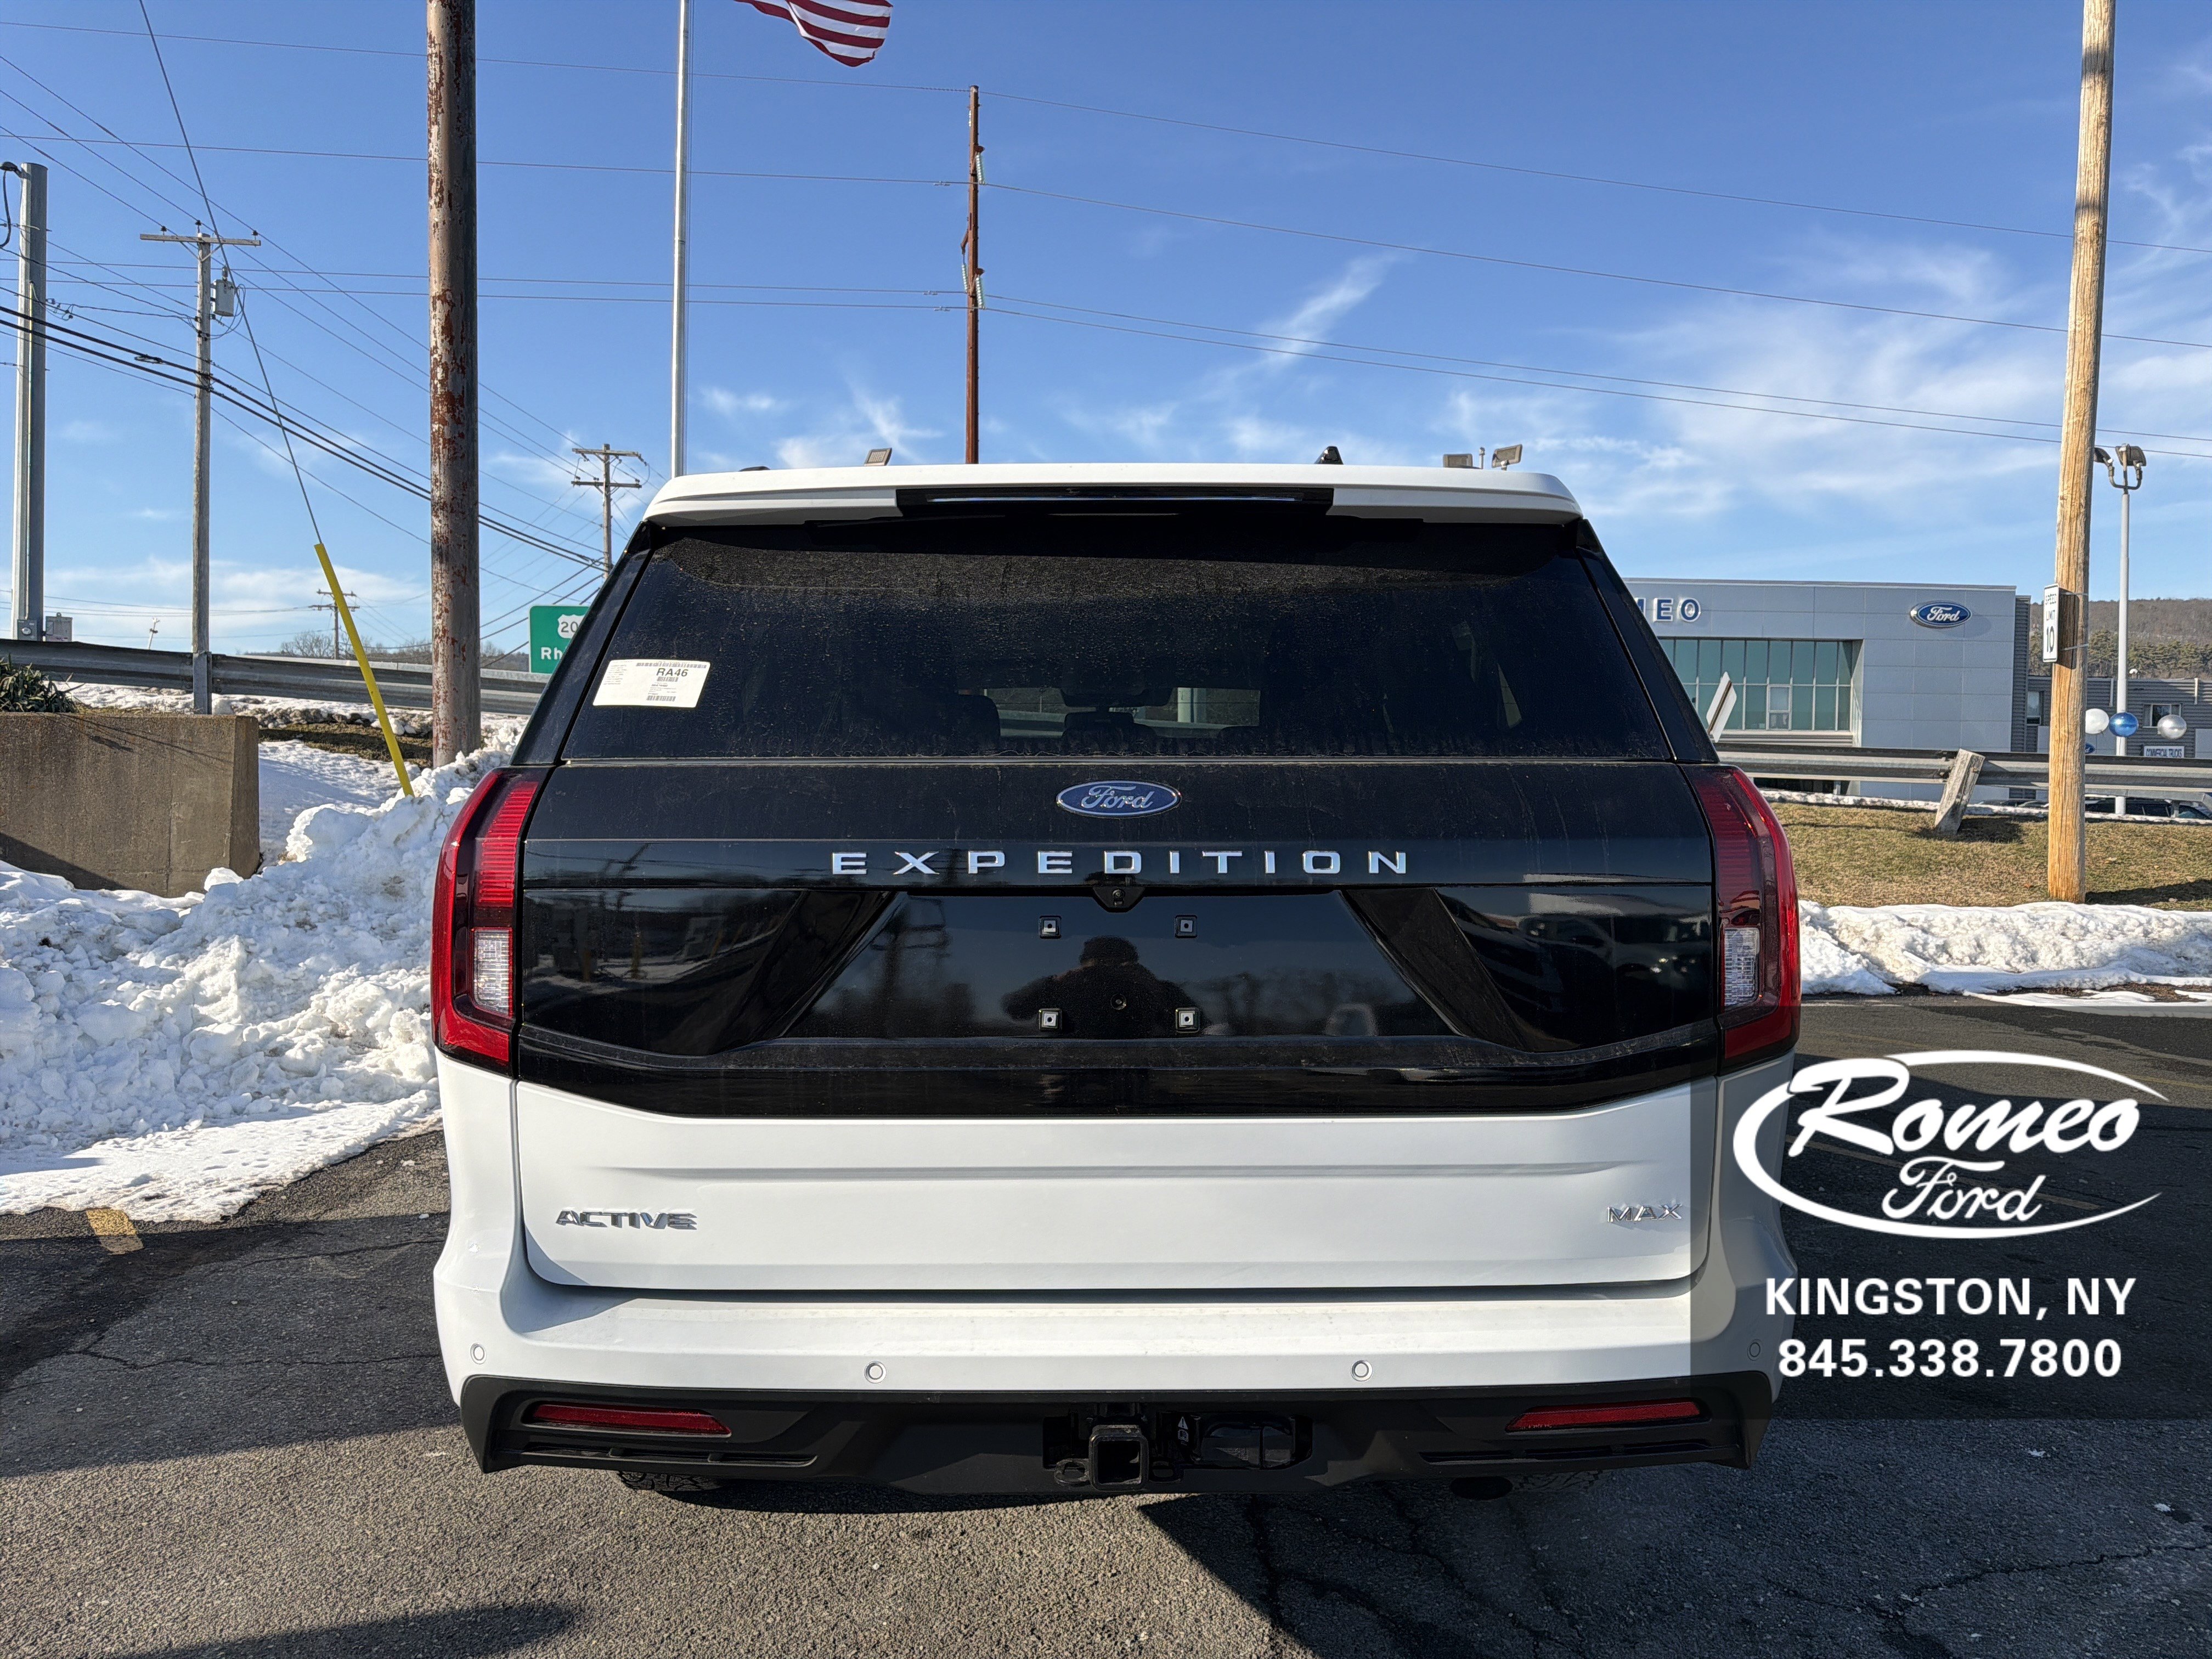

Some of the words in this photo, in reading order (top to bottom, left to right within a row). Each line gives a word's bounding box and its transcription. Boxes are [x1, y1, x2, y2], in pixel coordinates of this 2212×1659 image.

[1927, 606, 1960, 622] Ford
[2046, 610, 2056, 621] LIMIT
[561, 621, 579, 633] 20
[2046, 625, 2055, 653] 10
[541, 647, 563, 660] Rh
[656, 668, 689, 677] RA46
[1081, 786, 1155, 809] Ford
[831, 850, 1407, 874] EXPEDITION
[555, 1210, 697, 1230] ACTIVE
[1607, 1204, 1683, 1222] MAX
